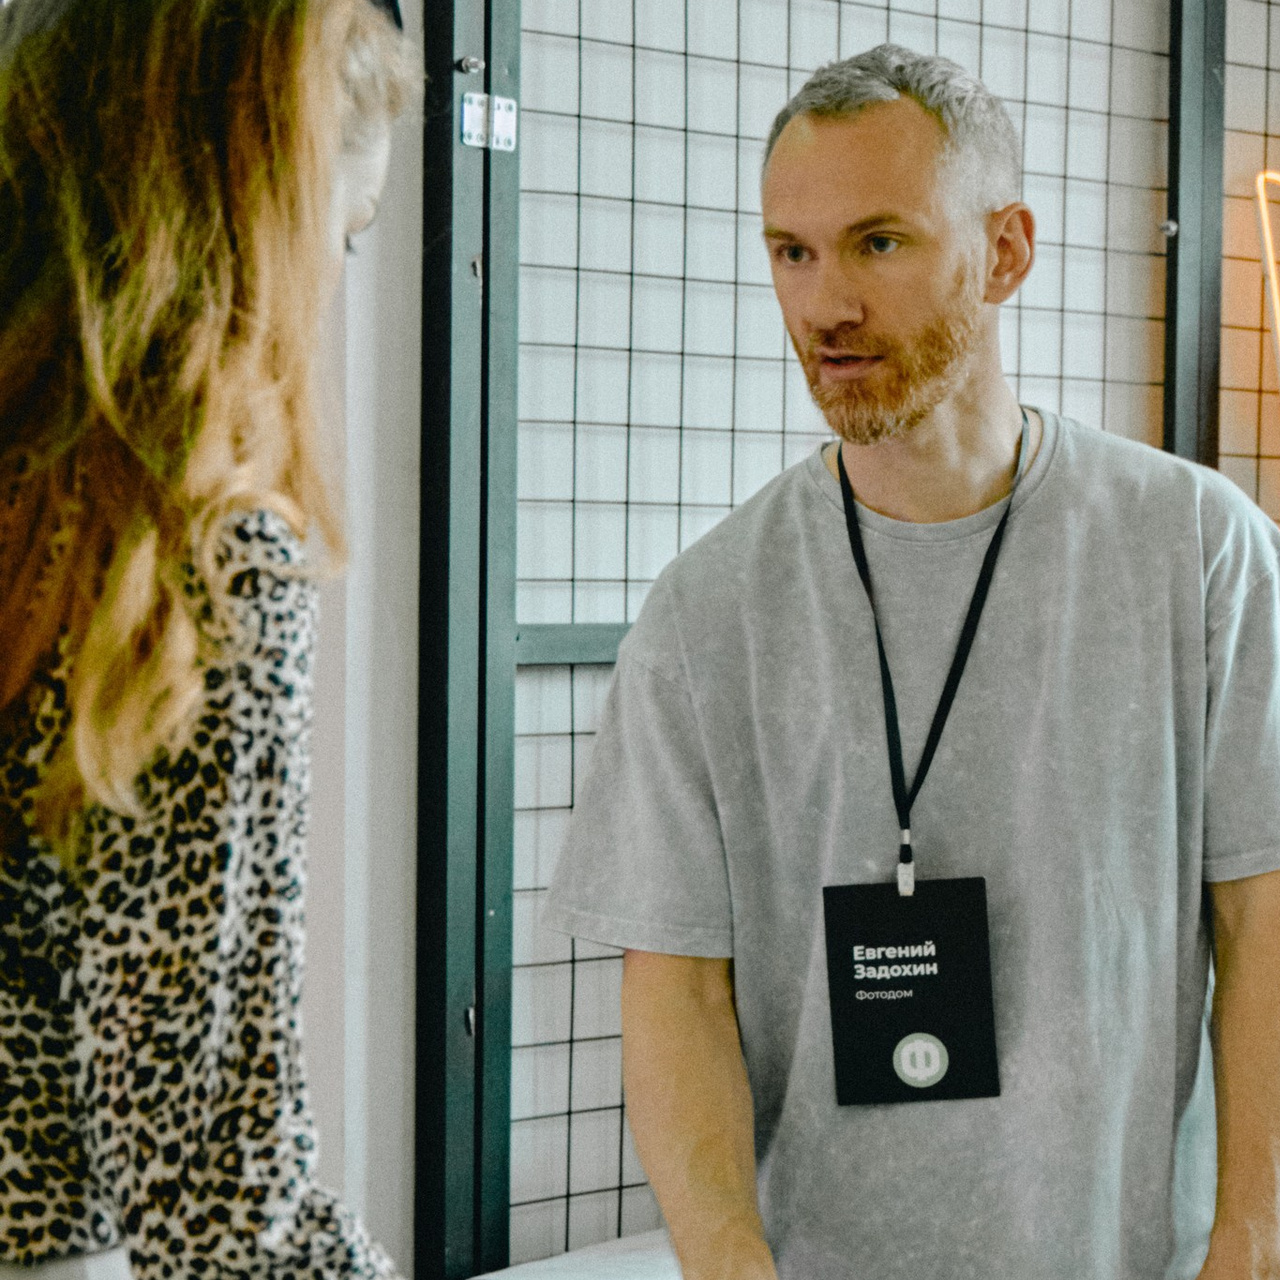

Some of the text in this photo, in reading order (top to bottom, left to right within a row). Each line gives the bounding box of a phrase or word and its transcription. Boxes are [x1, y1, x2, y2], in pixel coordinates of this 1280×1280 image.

[853, 941, 936, 960] Евгений
[854, 962, 938, 980] Задохин
[855, 989, 913, 1001] Фотодом
